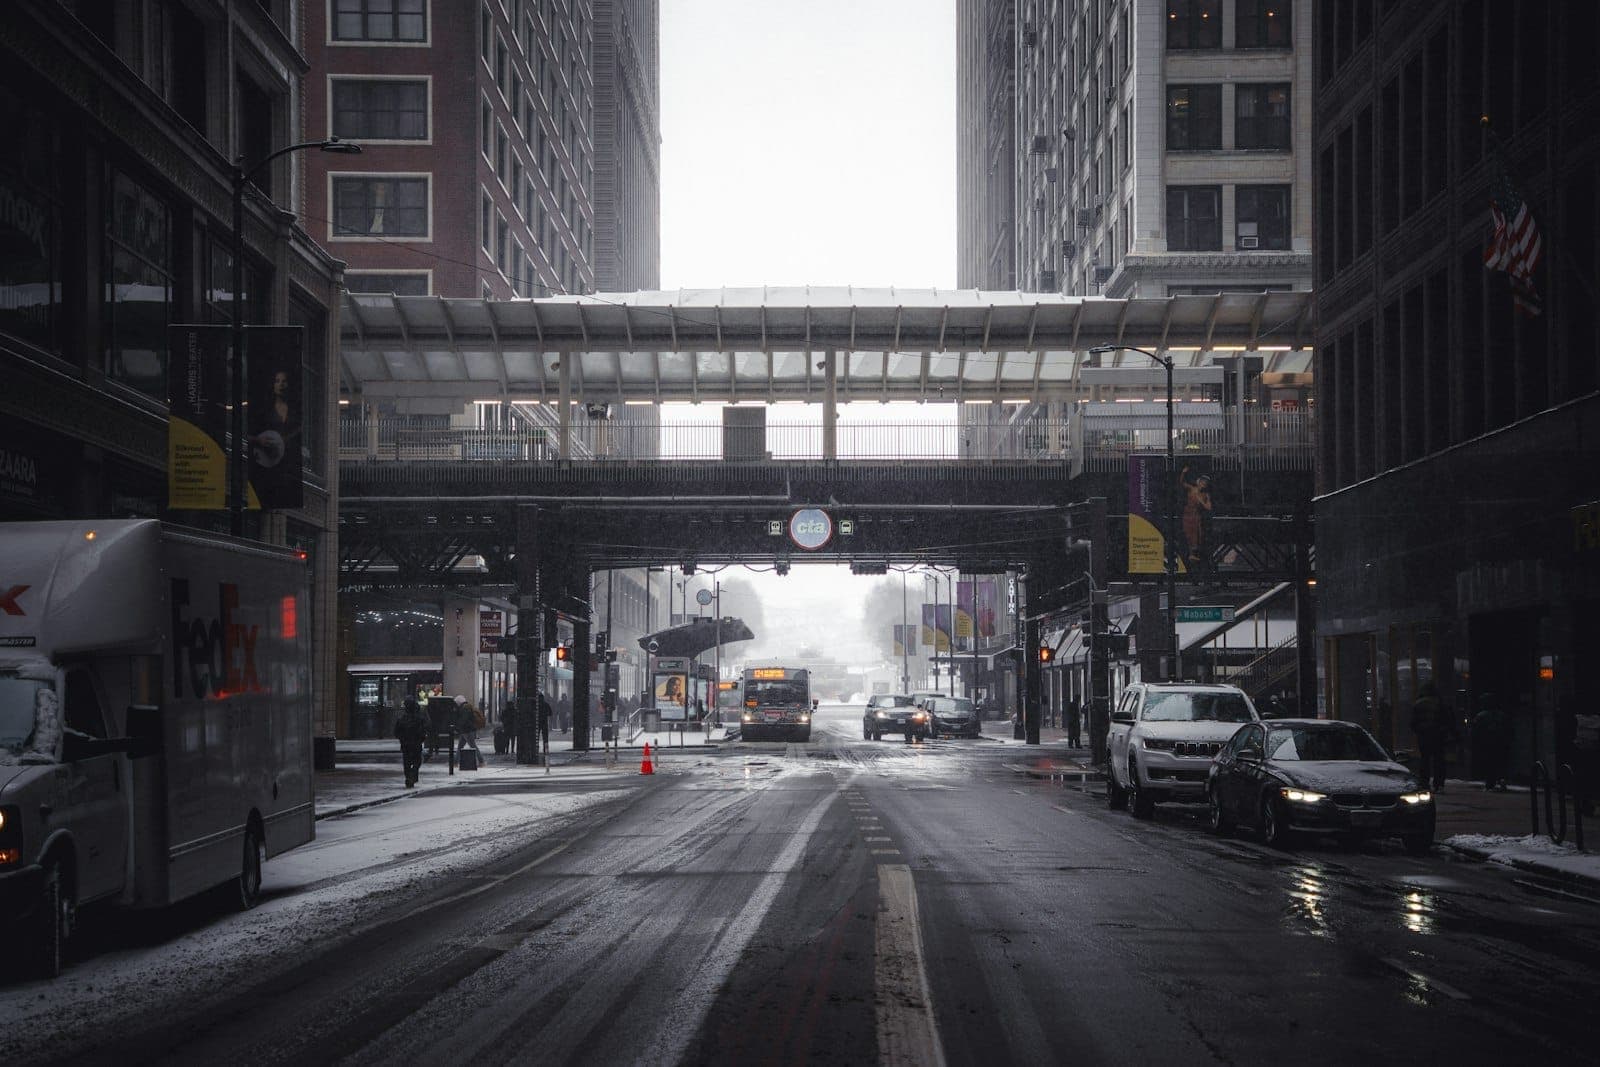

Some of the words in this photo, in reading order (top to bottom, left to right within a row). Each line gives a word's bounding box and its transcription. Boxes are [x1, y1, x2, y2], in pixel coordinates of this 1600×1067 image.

[797, 519, 825, 535] cta
[1183, 609, 1213, 619] Wabash
[171, 578, 262, 699] FedEx
